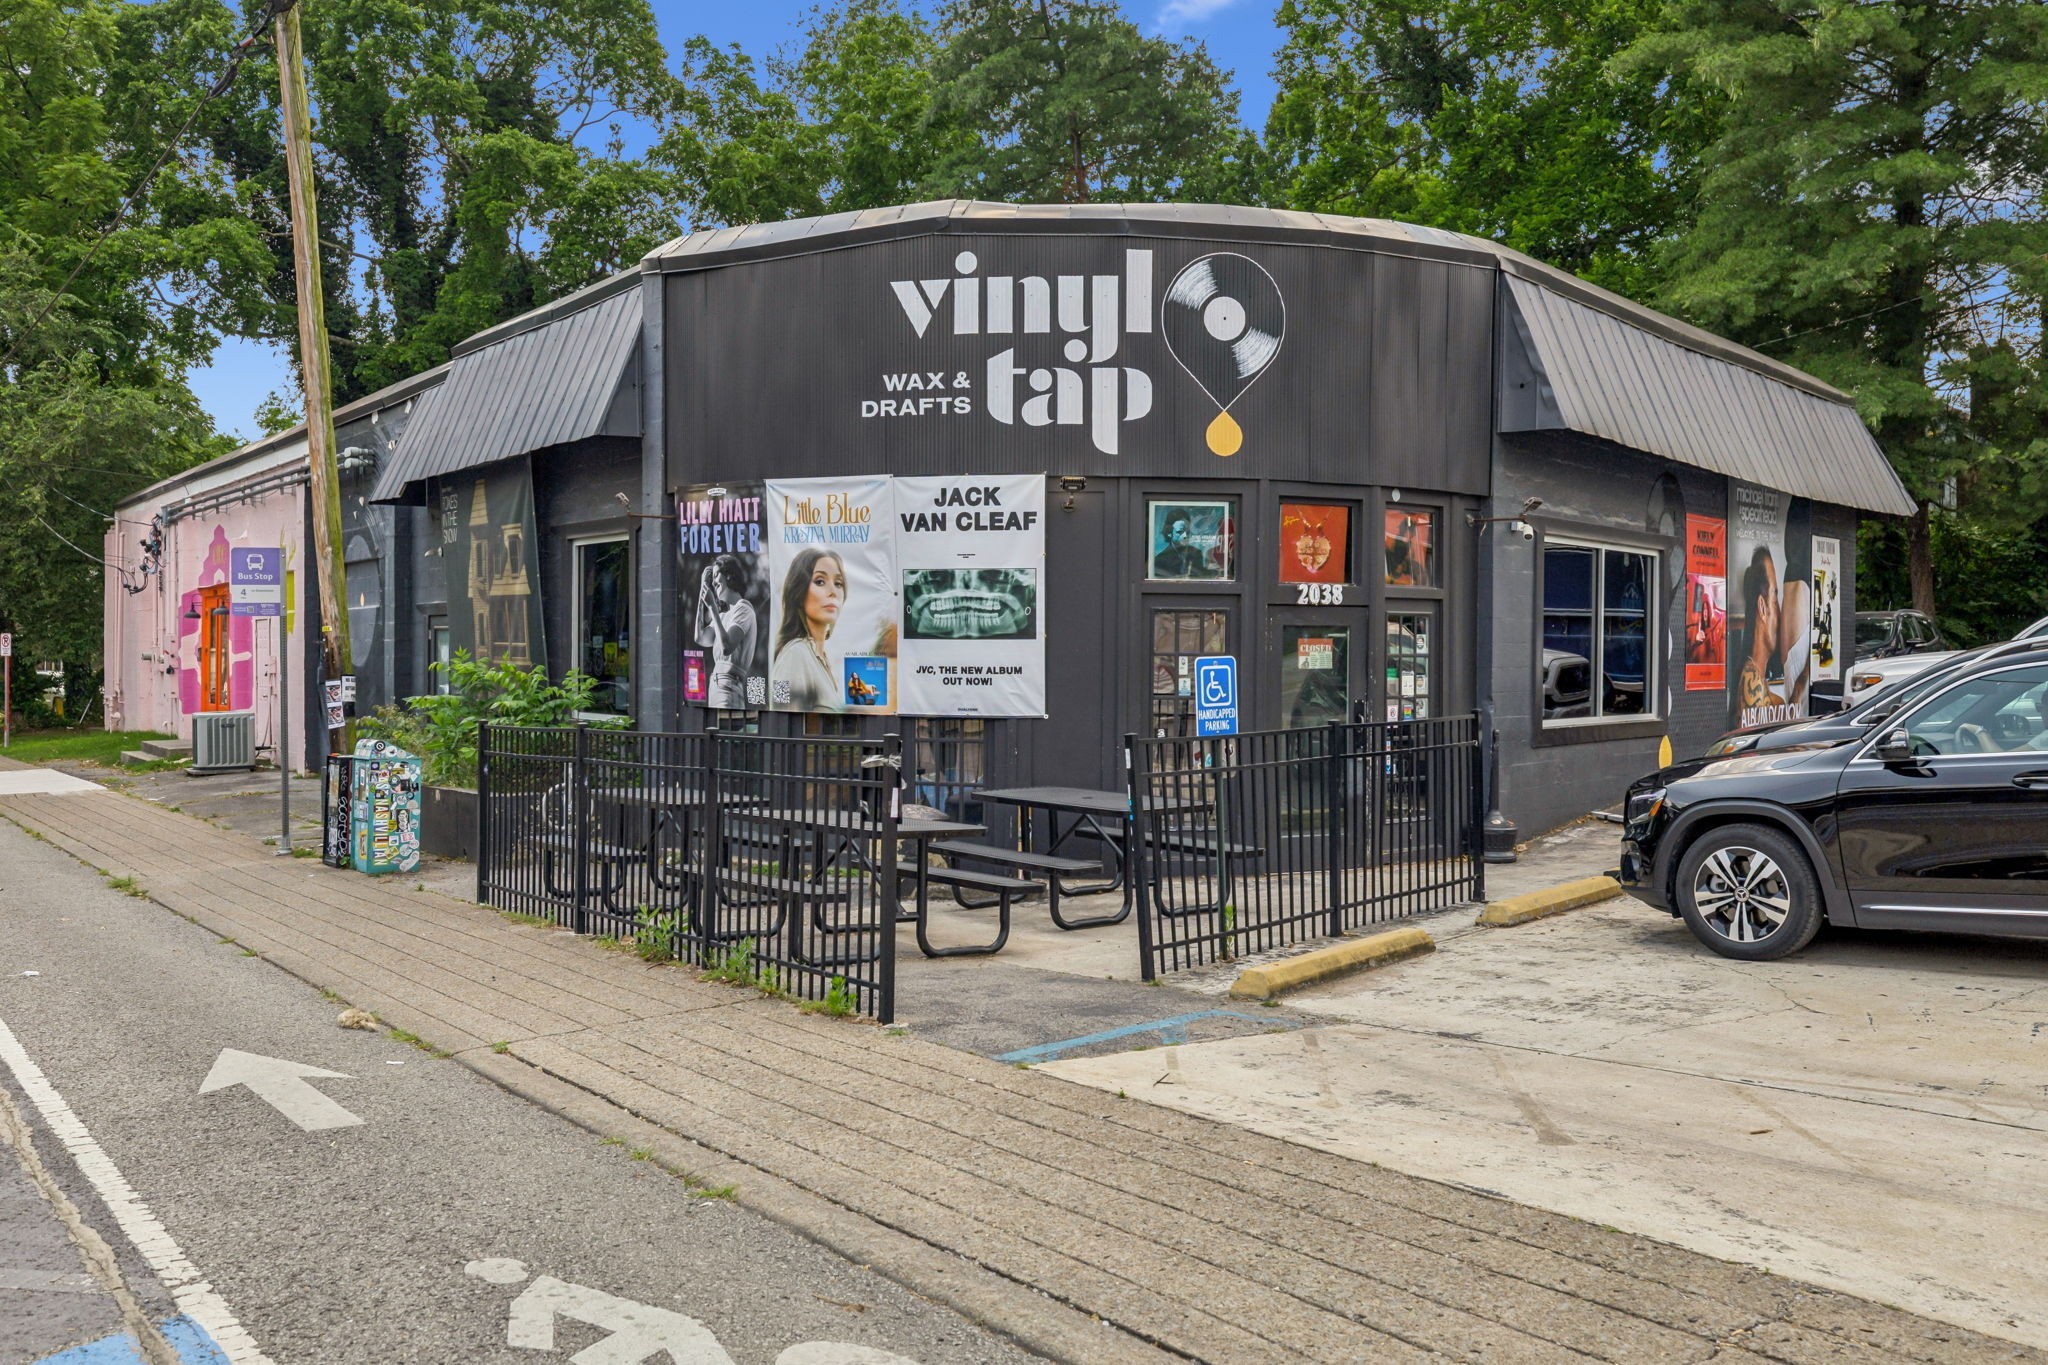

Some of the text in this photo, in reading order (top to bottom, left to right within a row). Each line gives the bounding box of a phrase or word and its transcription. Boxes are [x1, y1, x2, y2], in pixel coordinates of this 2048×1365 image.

[890, 248, 1152, 364] vinyl
[883, 371, 971, 392] WAX &
[861, 396, 971, 418] DRAFTS
[986, 348, 1153, 455] tap
[934, 487, 1001, 507] JACK
[680, 497, 760, 525] LILLY HIATT
[784, 492, 871, 525] Little Blue
[900, 511, 1037, 532] VAN CLEAF
[680, 523, 761, 554] FOREVER
[828, 525, 871, 544] MURRAY
[254, 572, 274, 581] Stop
[240, 588, 247, 596] 4
[1296, 583, 1343, 605] 2038
[1300, 643, 1331, 653] CLOSED
[916, 666, 1022, 675] JVC, THE NEW ALBUM
[943, 677, 993, 685] OUT NOW!
[1198, 708, 1236, 721] HANDICAPPED
[1741, 706, 1768, 728] ALBUM
[1768, 704, 1784, 724] OUT
[1205, 720, 1230, 732] PARKING
